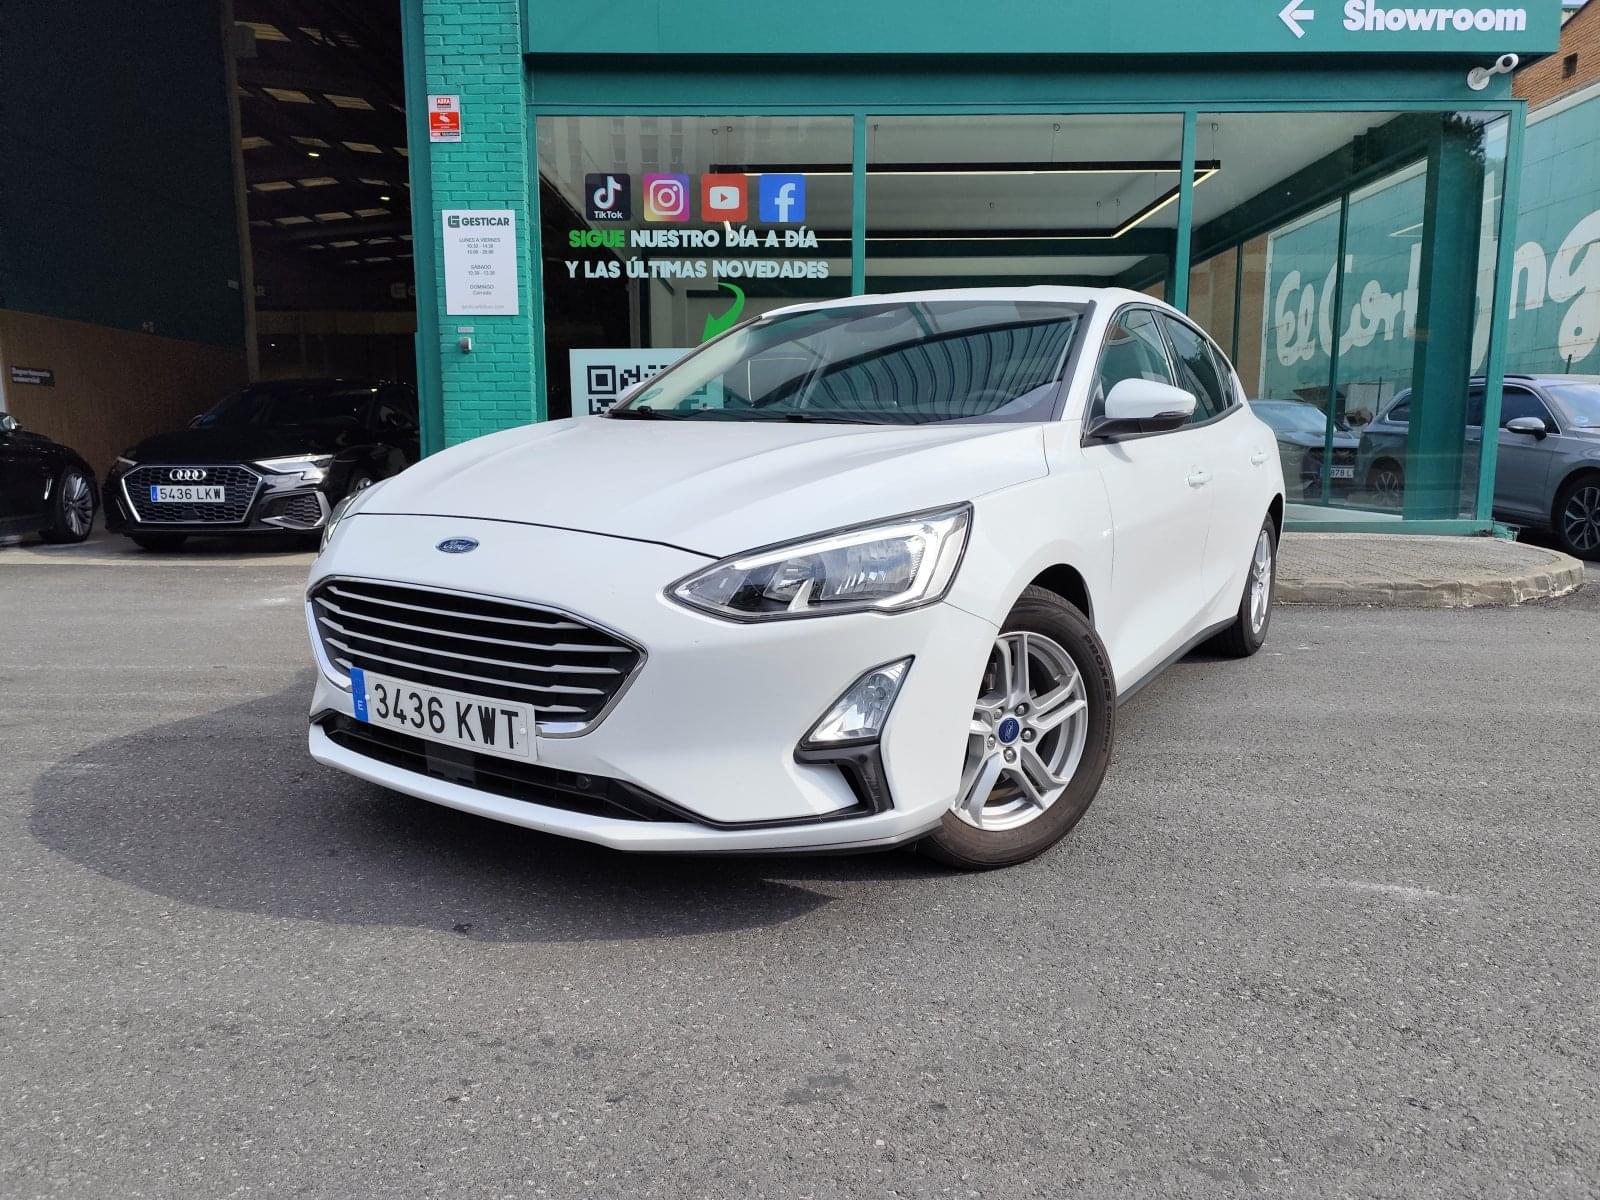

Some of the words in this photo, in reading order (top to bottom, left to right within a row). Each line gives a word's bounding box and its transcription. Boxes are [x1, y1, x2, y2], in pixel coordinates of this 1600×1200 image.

[1342, 0, 1527, 32] Showroom
[461, 217, 510, 227] GESTICAR
[593, 210, 624, 219] TikTok
[568, 229, 625, 248] SIGUE
[630, 229, 720, 248] NUESTRO
[725, 225, 760, 248] DÍA
[764, 229, 780, 248] A
[784, 225, 819, 248] DÍA
[564, 260, 578, 279] Y
[584, 260, 622, 279] LAS
[626, 256, 708, 279] ÚLTIMAS
[712, 260, 829, 280] NOVEDADES
[160, 488, 193, 500] 5436
[196, 488, 221, 500] LKW
[373, 683, 446, 734] 3436
[455, 701, 519, 750] KWT
